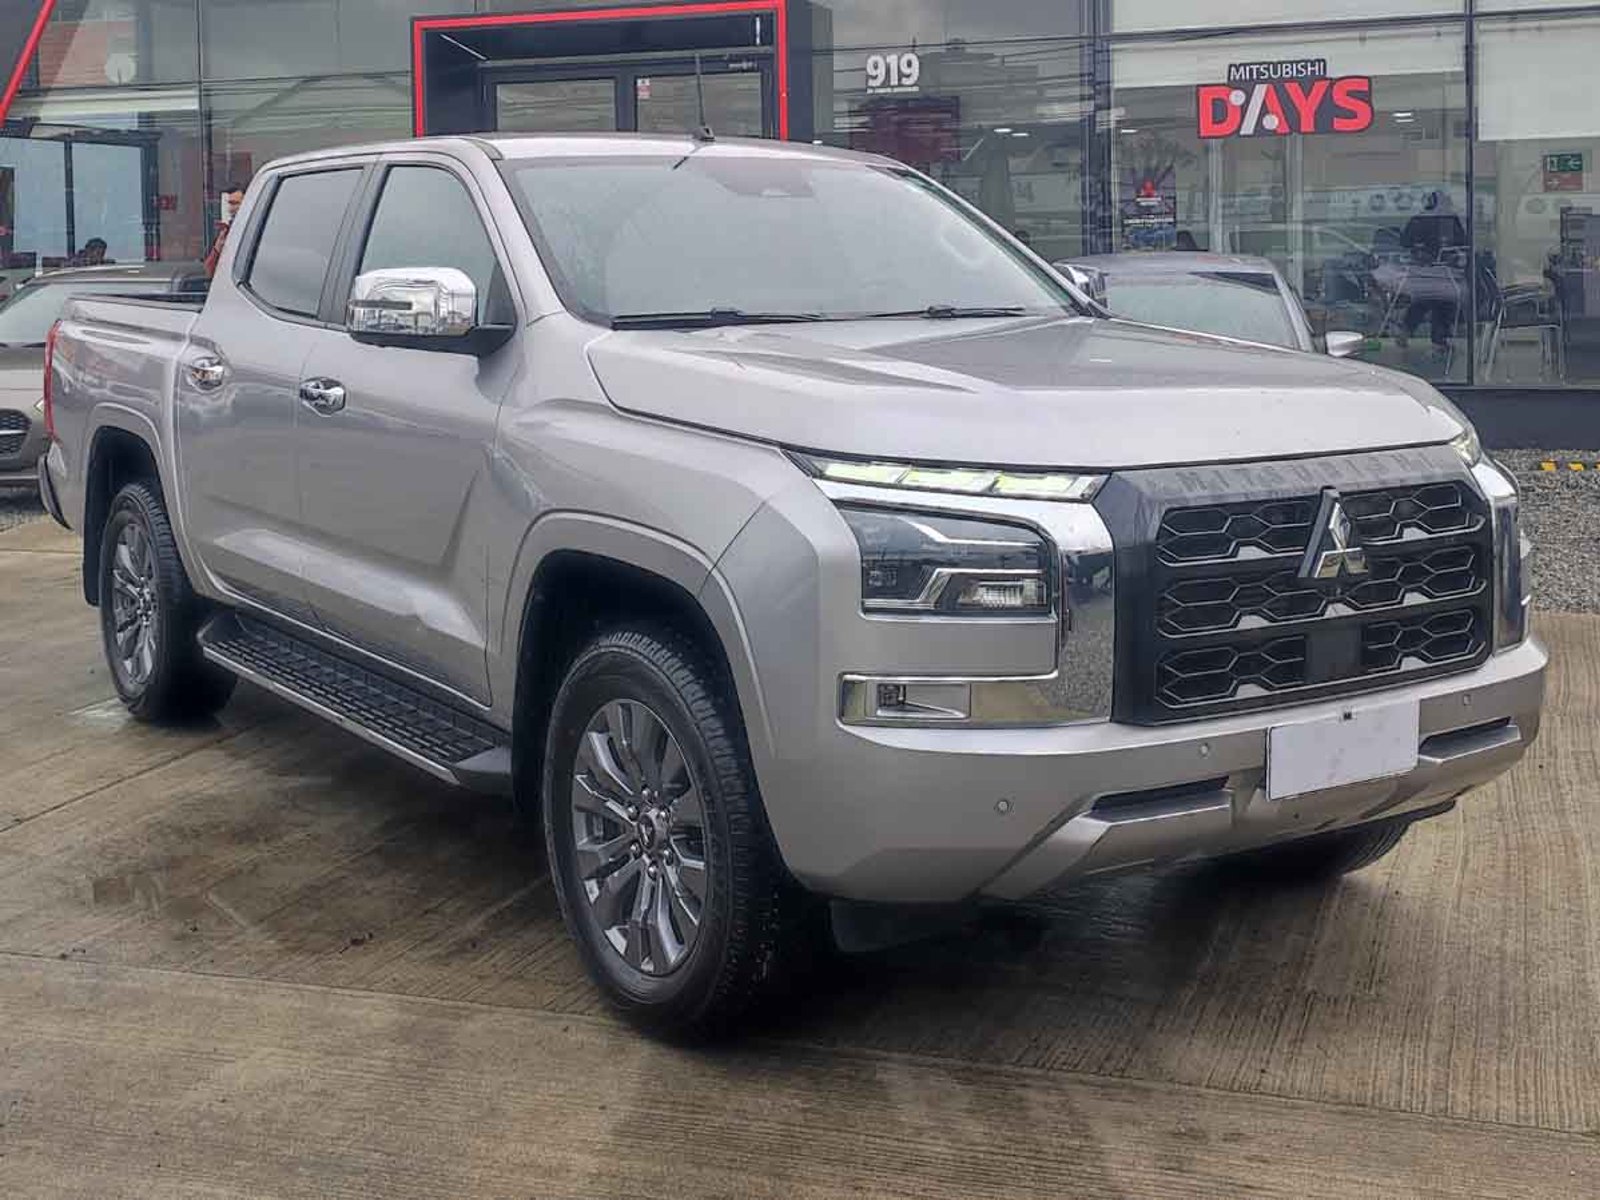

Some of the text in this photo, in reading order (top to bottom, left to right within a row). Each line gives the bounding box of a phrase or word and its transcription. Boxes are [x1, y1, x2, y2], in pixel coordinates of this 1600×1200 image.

[866, 52, 920, 87] 919
[1229, 60, 1326, 81] MITSUBISHI
[1198, 77, 1373, 138] DAYS
[1175, 451, 1435, 490] MITSUBISHI
